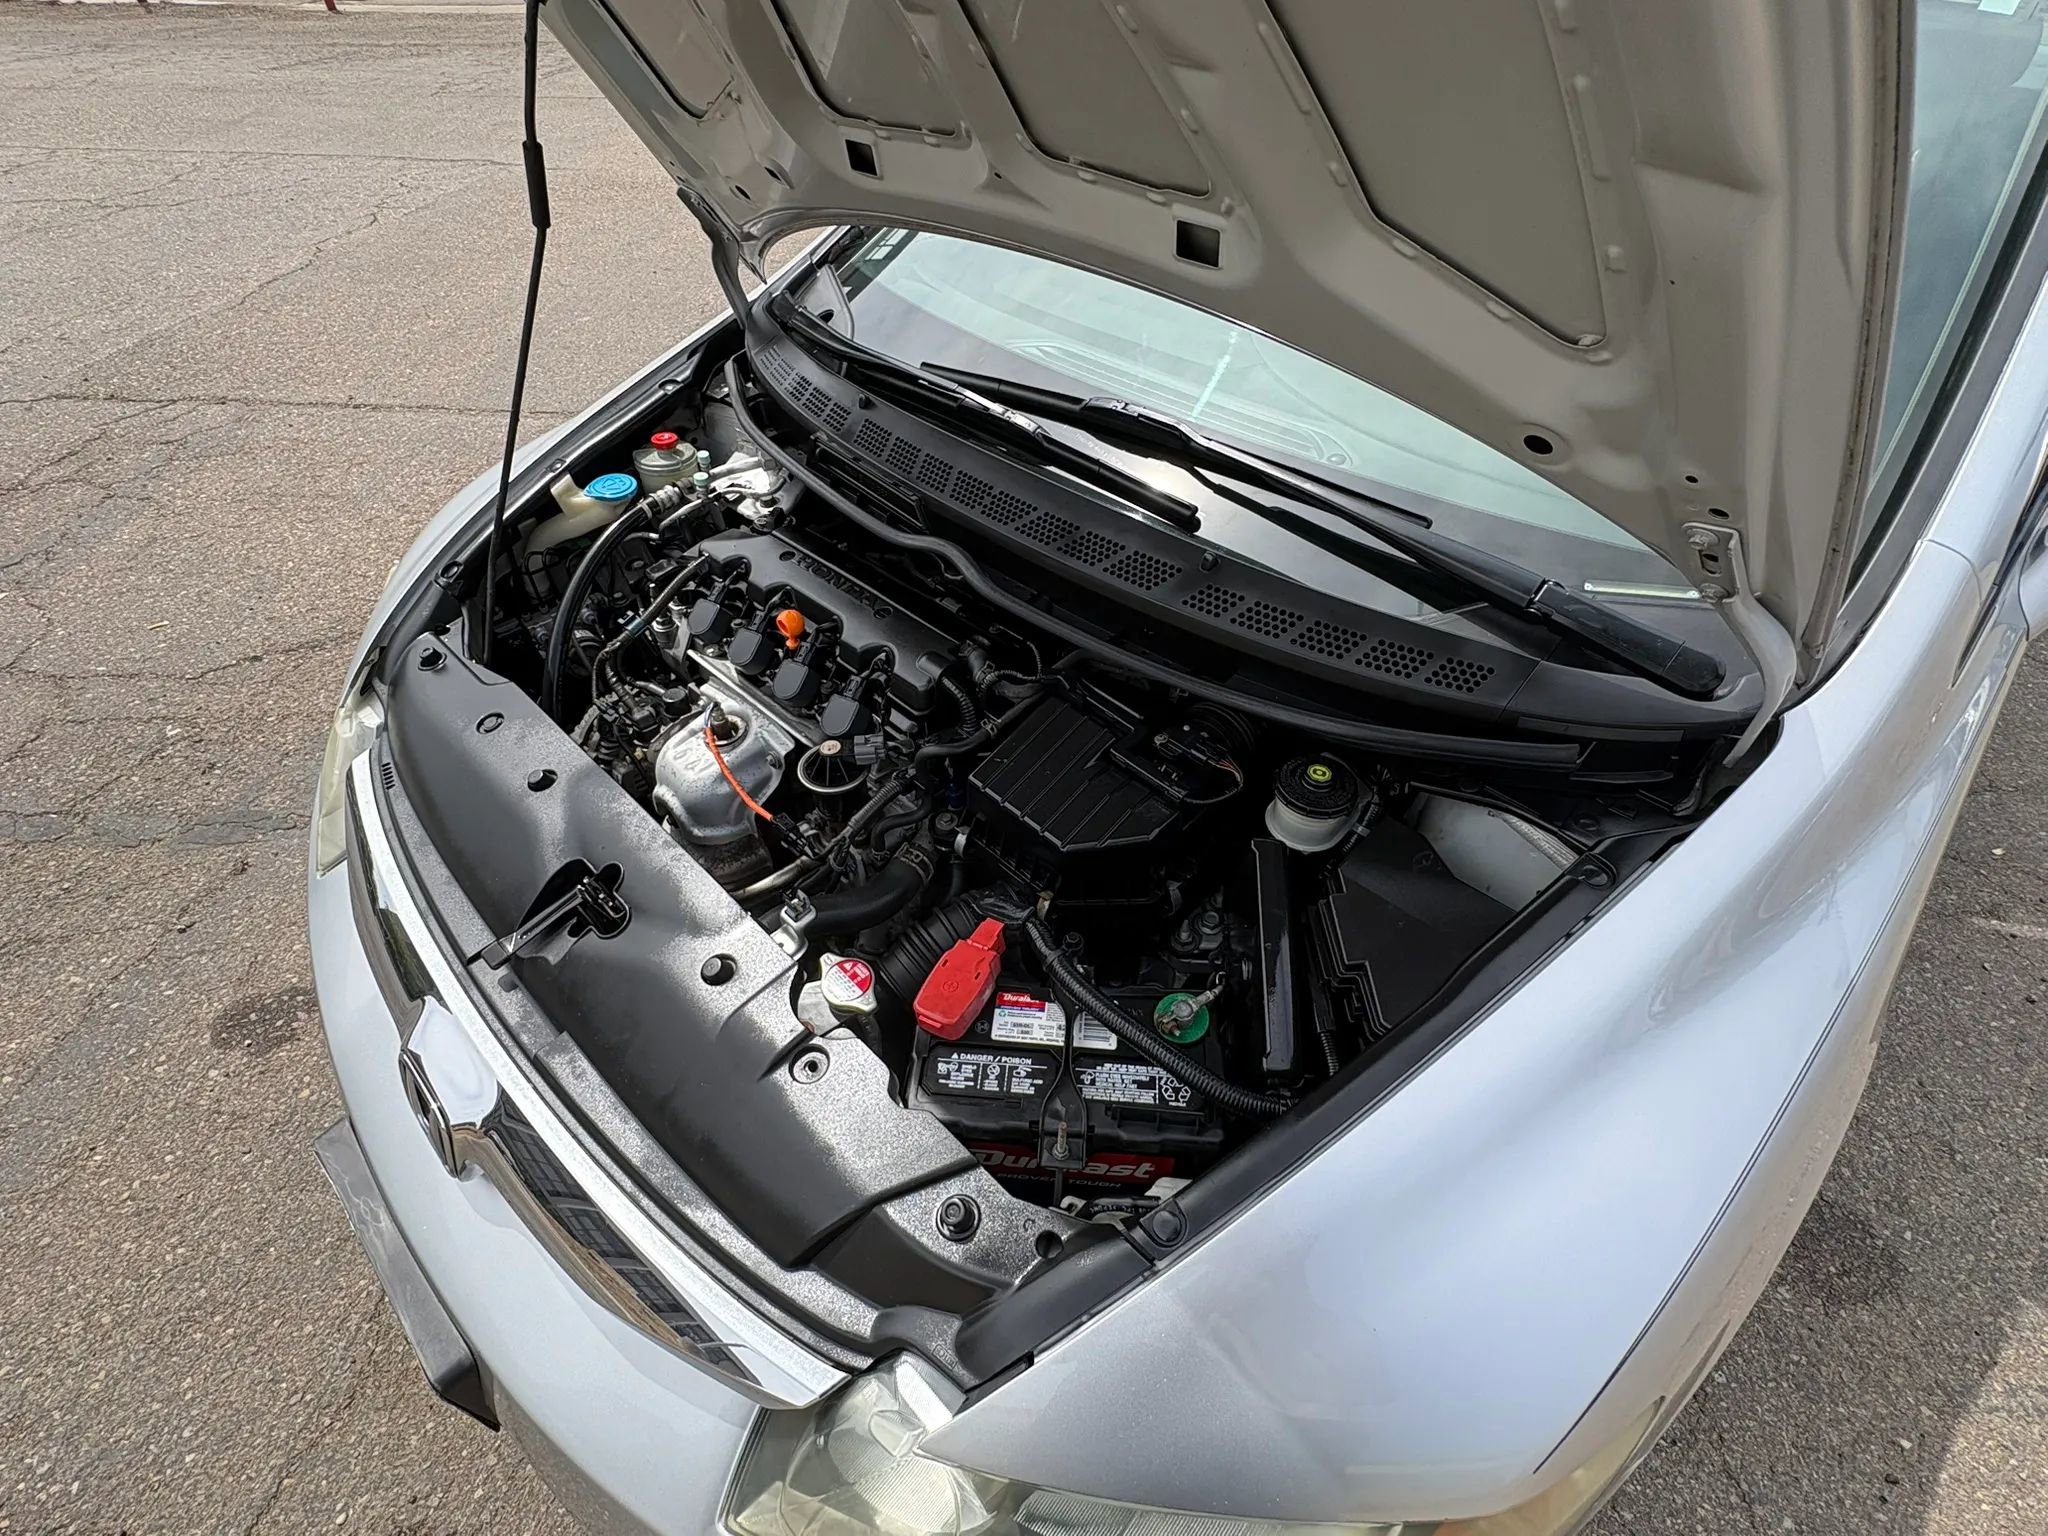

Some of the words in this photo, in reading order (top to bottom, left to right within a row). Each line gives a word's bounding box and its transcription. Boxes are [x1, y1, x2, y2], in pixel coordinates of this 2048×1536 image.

[792, 552, 879, 610] HONDA
[960, 1053, 994, 1062] DANGER
[1001, 1056, 1032, 1065] POISON
